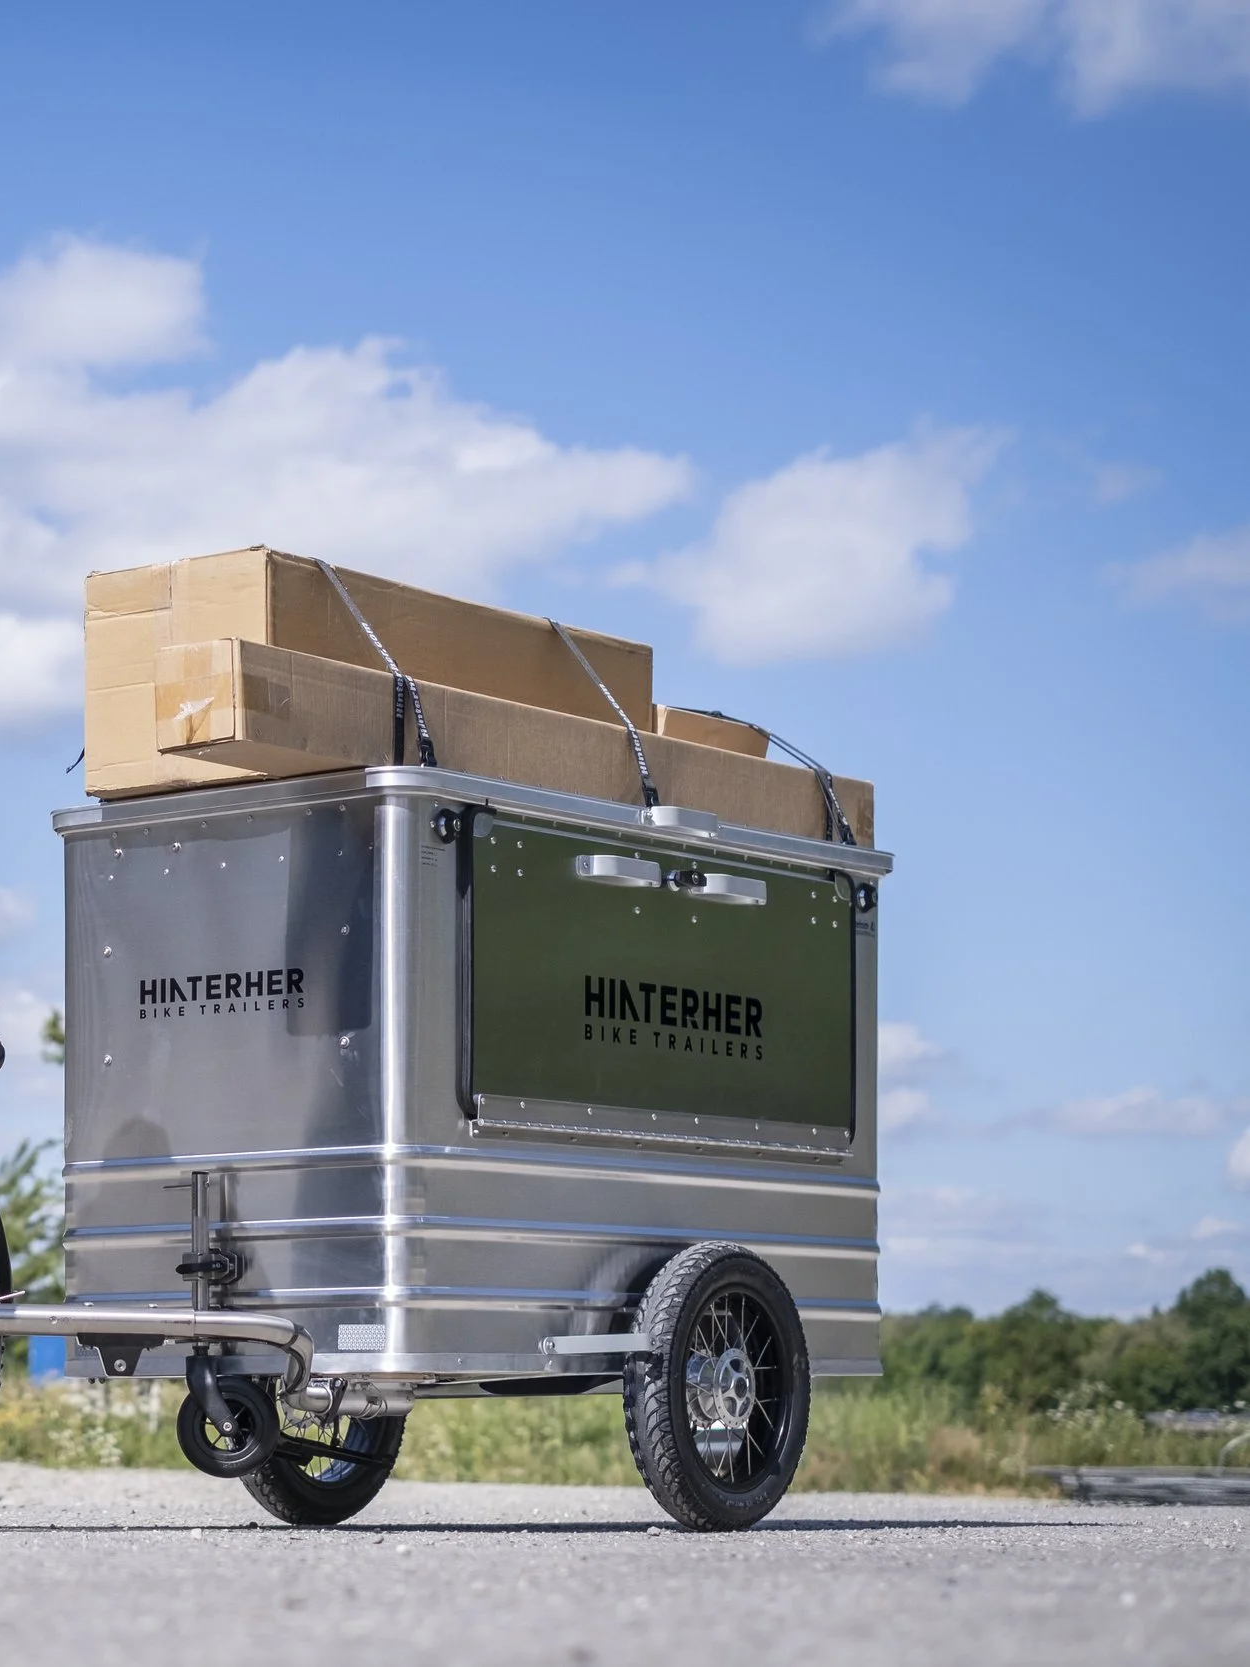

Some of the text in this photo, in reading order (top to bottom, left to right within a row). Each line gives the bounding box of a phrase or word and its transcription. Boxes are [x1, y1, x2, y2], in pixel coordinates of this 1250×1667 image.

[139, 967, 304, 1005] HINTERHER
[139, 998, 305, 1019] BIKE TRAILERS
[584, 975, 763, 1038] HINTERHER
[584, 1024, 763, 1060] BIKE TRAILERS
